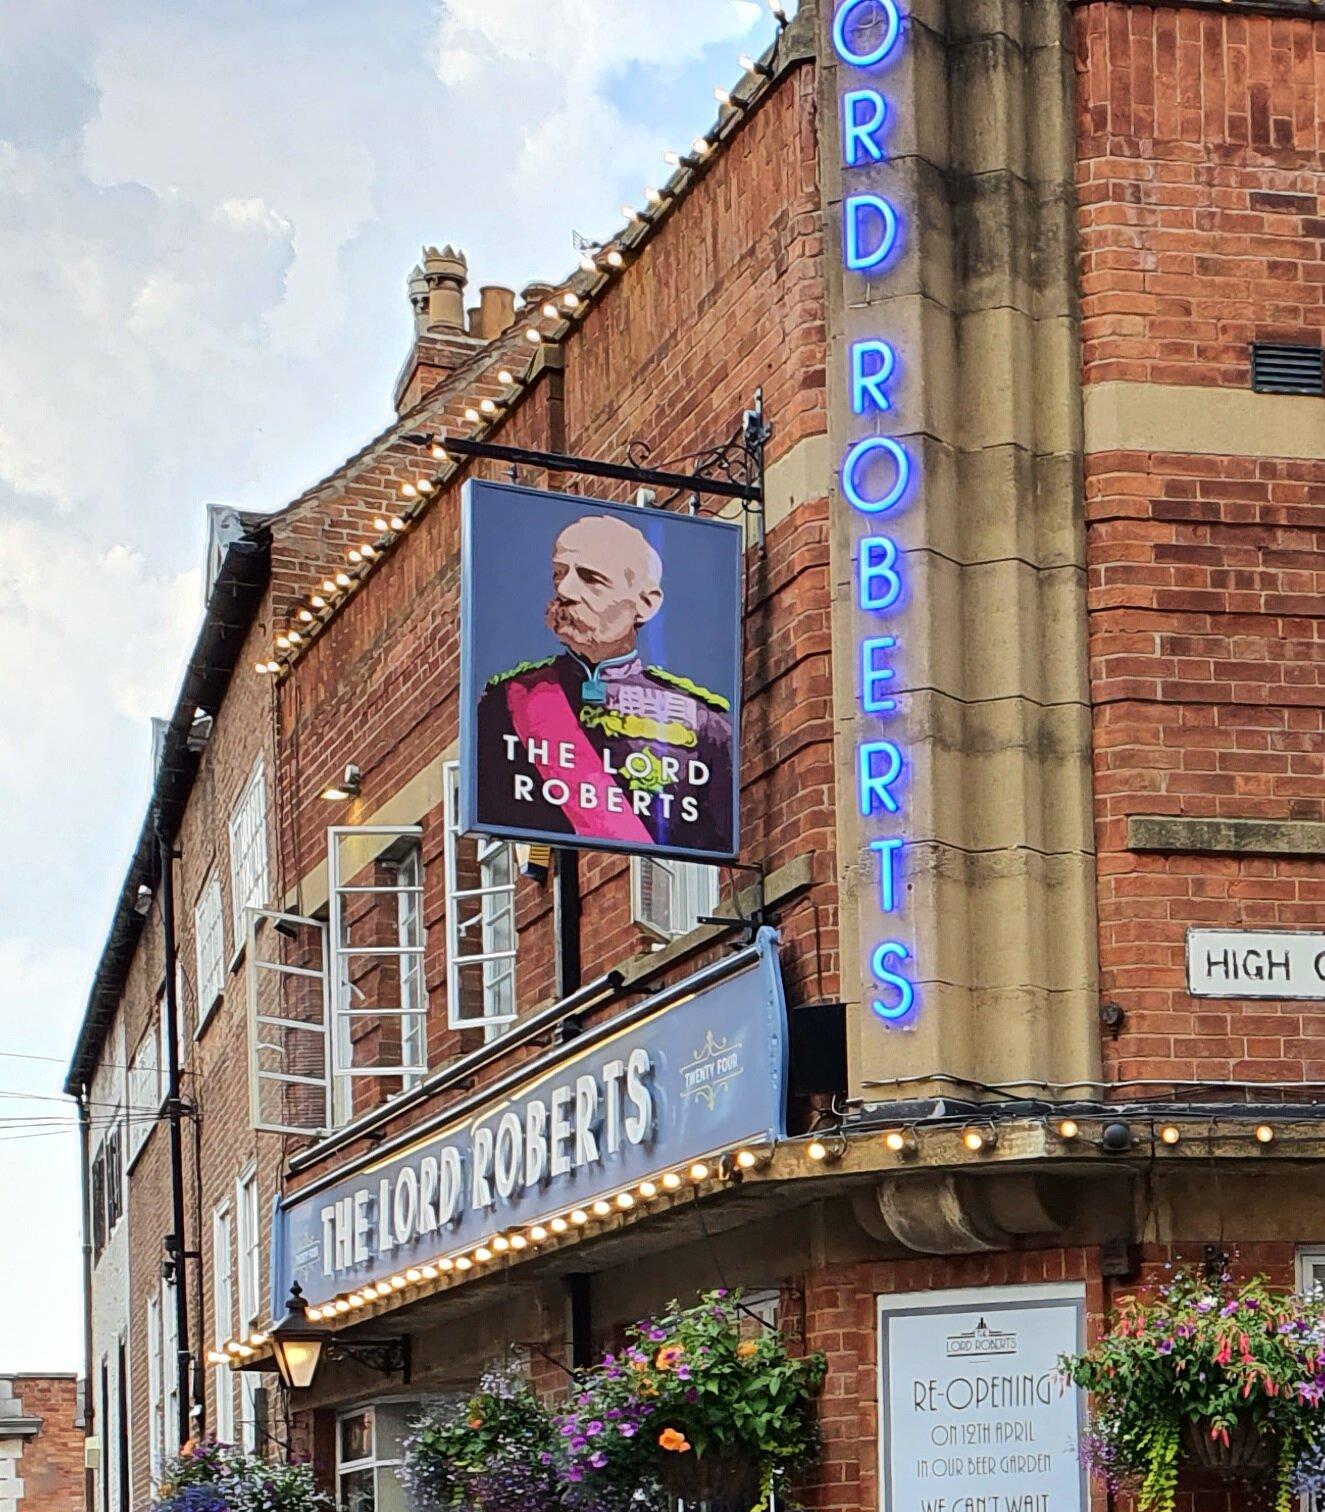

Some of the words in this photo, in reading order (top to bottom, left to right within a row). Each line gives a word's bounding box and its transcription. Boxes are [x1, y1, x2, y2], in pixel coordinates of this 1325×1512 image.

[842, 339, 914, 1020] ROBERTS
[502, 734, 575, 768] THE
[603, 748, 710, 786] LORD
[514, 774, 699, 822] ROBERTS
[1205, 948, 1291, 982] HIGH
[684, 1061, 716, 1089] TWENTY
[717, 1052, 739, 1075] FOUR
[320, 1188, 369, 1277] THE
[379, 1146, 462, 1252] LORD
[472, 1048, 652, 1209] ROBERTS
[946, 1340, 973, 1352] LORD
[975, 1337, 1017, 1350] ROBERTS
[914, 1374, 1051, 1411] RE-OPENING
[931, 1424, 957, 1446] ON
[961, 1423, 991, 1445] 12TH
[995, 1421, 1036, 1443] APRIL
[917, 1458, 928, 1478] IN
[932, 1457, 964, 1477] OUR
[968, 1455, 996, 1475] BEER
[1000, 1454, 1051, 1474] GARDEN
